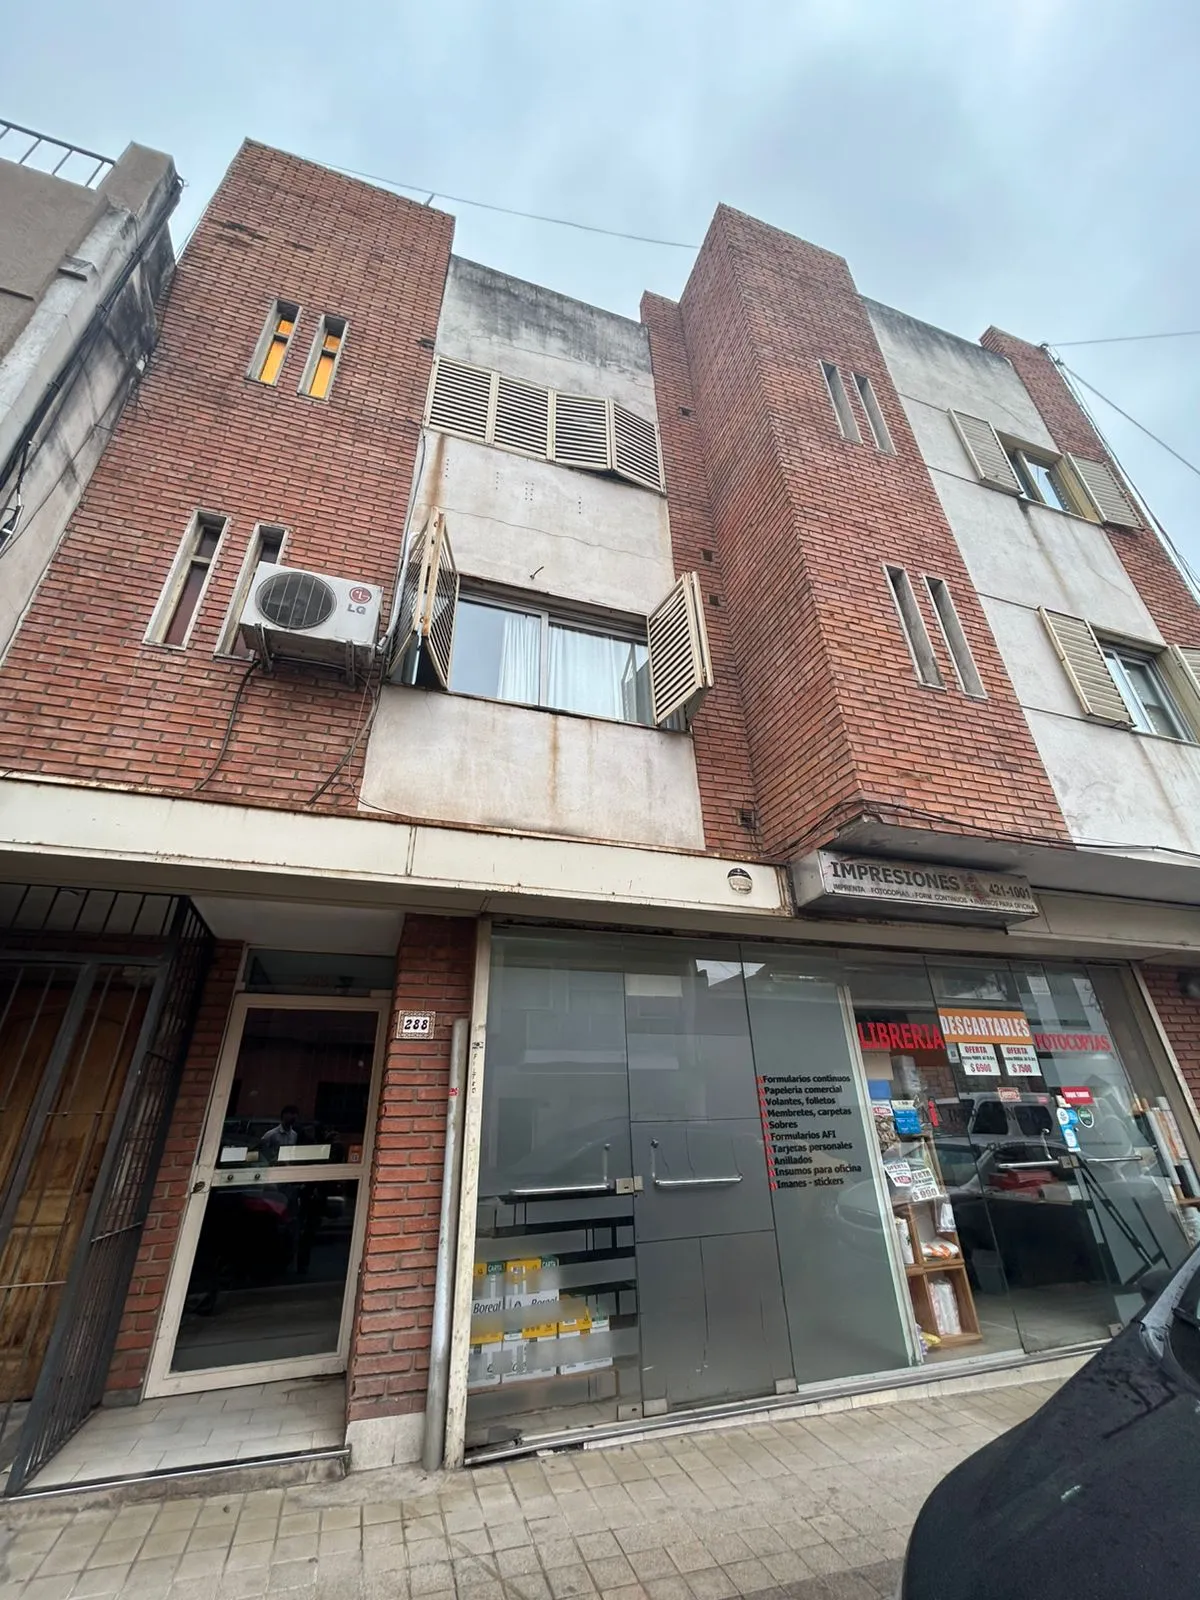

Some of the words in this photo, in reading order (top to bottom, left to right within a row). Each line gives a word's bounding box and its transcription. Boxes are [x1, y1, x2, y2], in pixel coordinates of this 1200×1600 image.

[347, 603, 366, 615] LG
[830, 861, 960, 891] IMPRESIONES
[833, 884, 865, 893] IMPRENTA
[989, 883, 1030, 899] 421-1001
[404, 1019, 428, 1030] 288
[939, 1015, 1030, 1038] DESCARTABLES
[857, 1022, 946, 1049] LIBRERIA
[1034, 1033, 1111, 1053] FOTOCOPIAS
[964, 1046, 988, 1054] OFERTA
[1006, 1047, 1028, 1055] OFERTA
[763, 1075, 811, 1083] Formularios
[804, 1085, 842, 1093] comercial
[766, 1097, 805, 1106] Volantes,
[806, 1097, 836, 1105] folletos
[767, 1109, 817, 1118] Membretes,
[818, 1108, 852, 1117] carpetas
[769, 1121, 798, 1129] Sobres
[770, 1131, 820, 1141] Formularios
[772, 1144, 807, 1155] Tarjetas
[809, 1142, 853, 1153] personales
[774, 1156, 813, 1165] Anillados
[775, 1167, 812, 1177] Insumos
[814, 1166, 832, 1175] para
[834, 1164, 862, 1173] oficina
[777, 1179, 807, 1189] Imanes
[814, 1177, 844, 1187] stickers
[473, 1300, 501, 1314] Boreal
